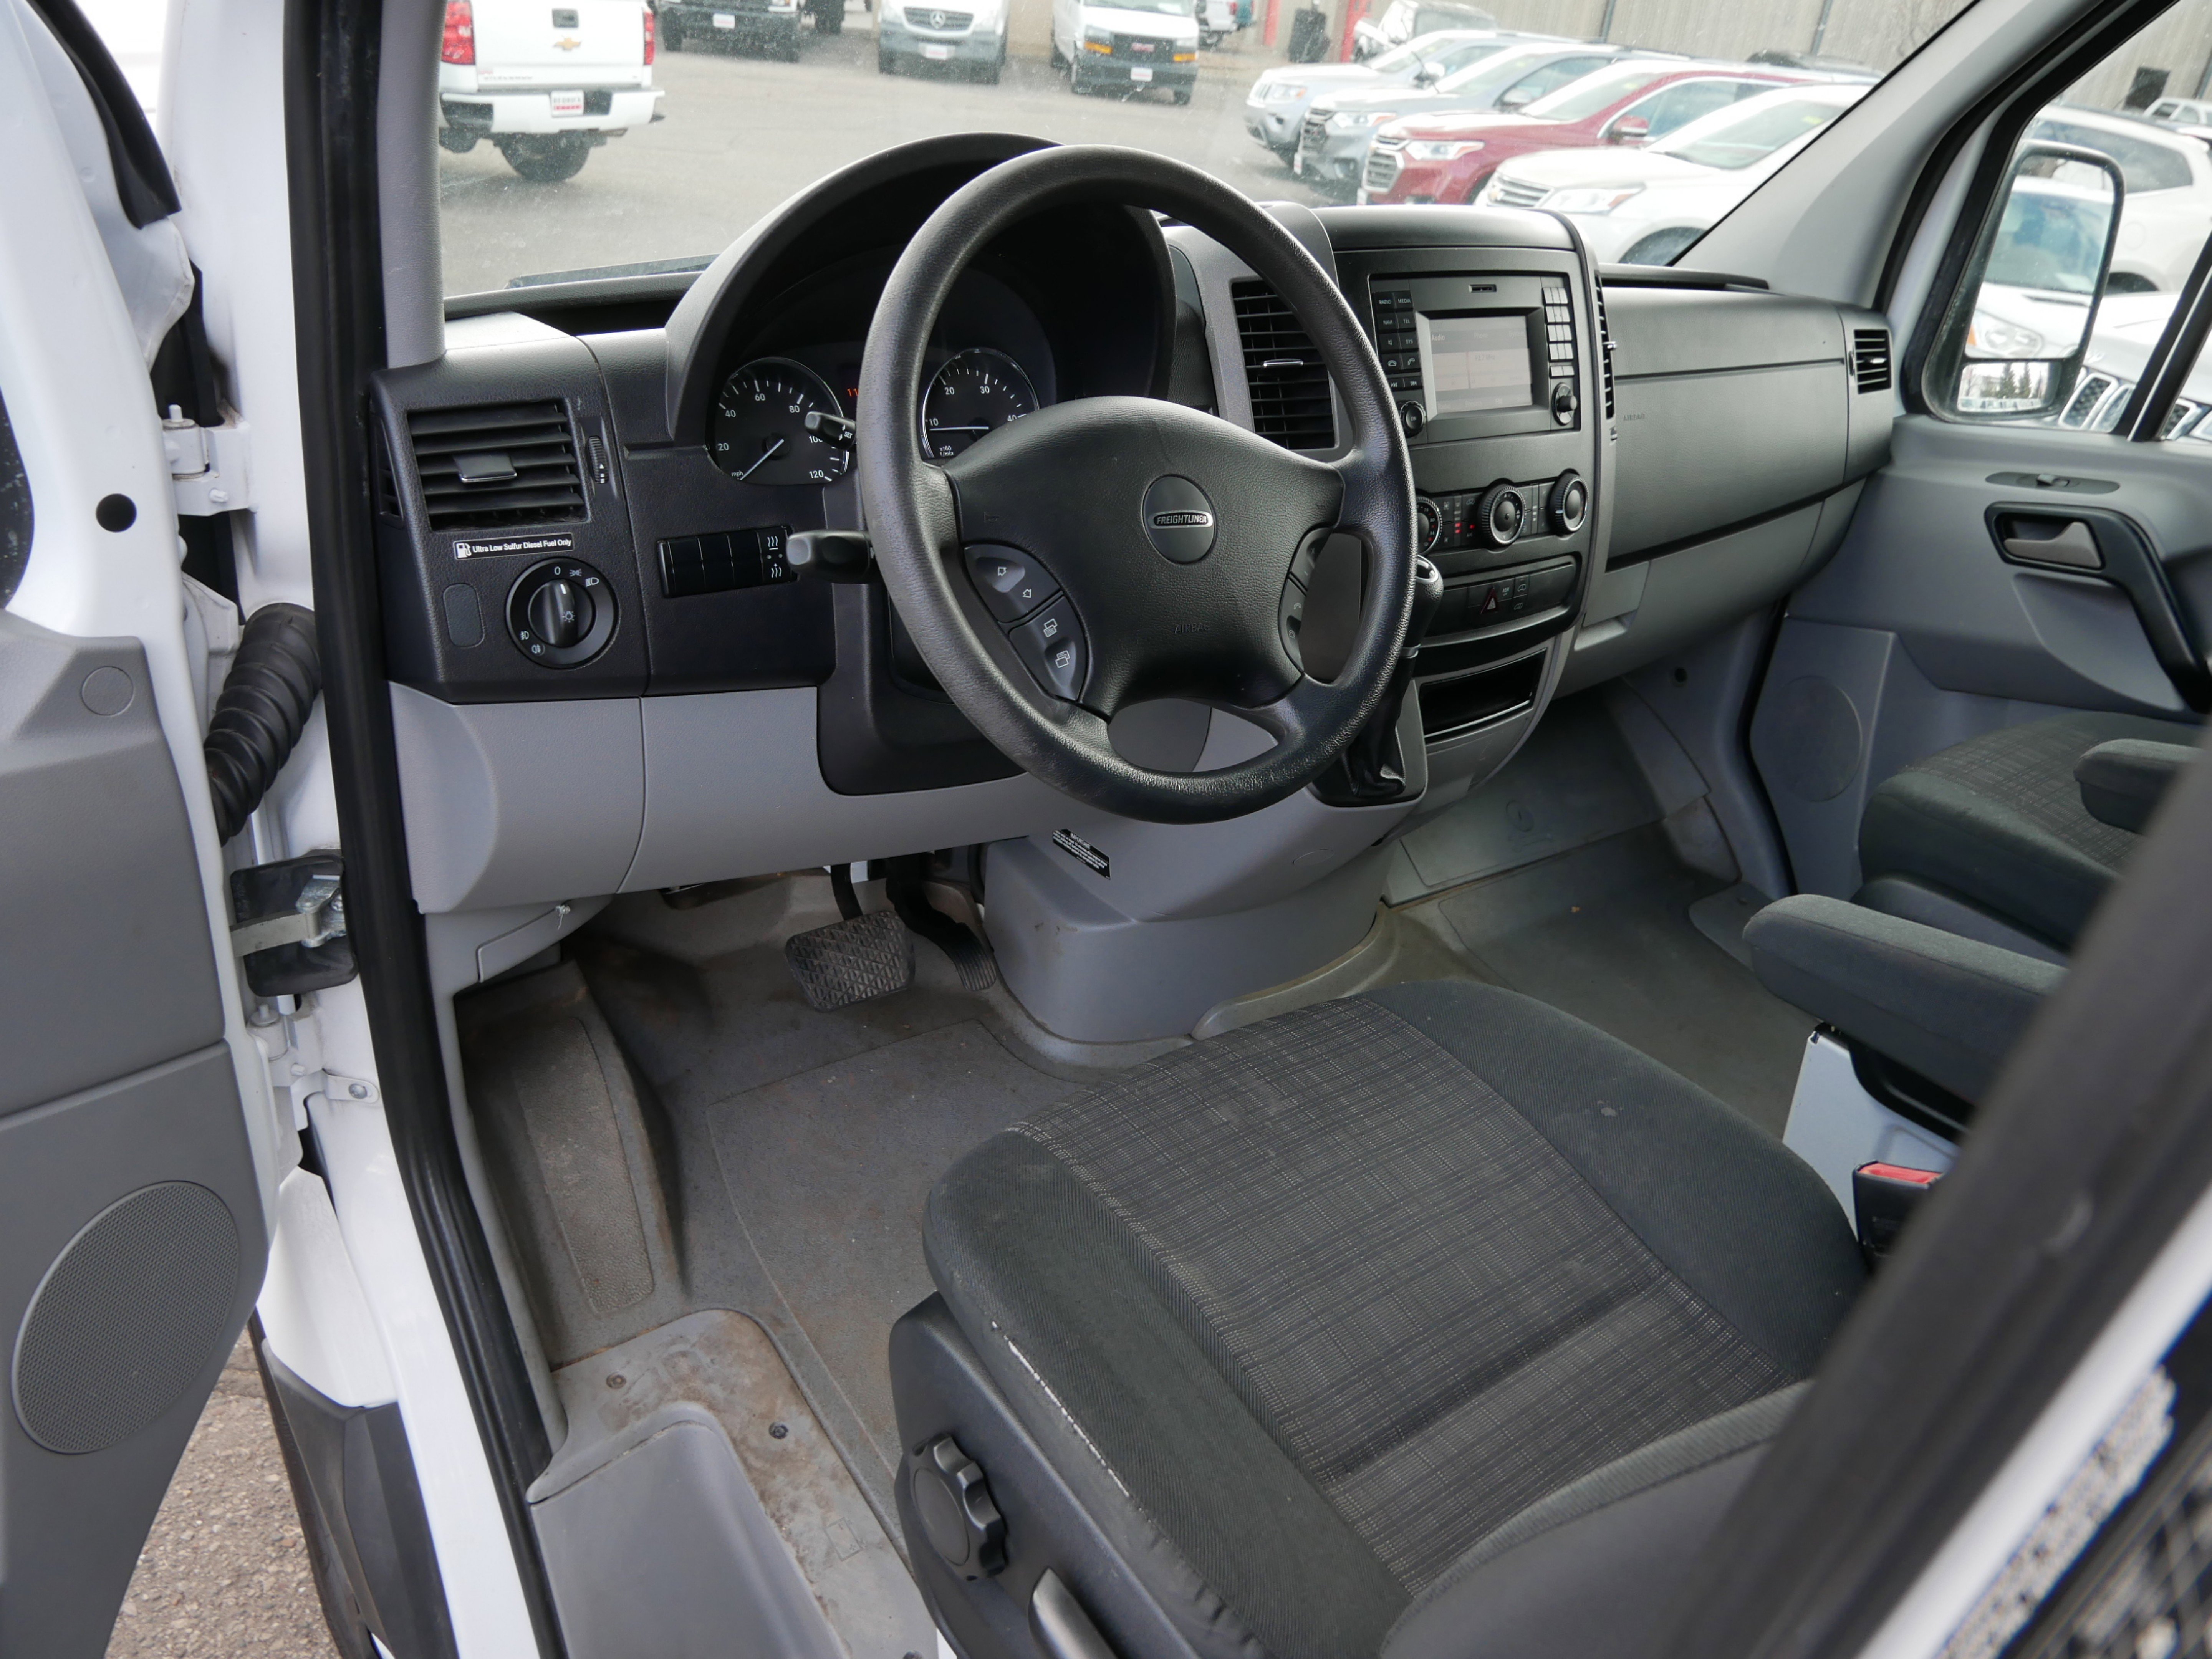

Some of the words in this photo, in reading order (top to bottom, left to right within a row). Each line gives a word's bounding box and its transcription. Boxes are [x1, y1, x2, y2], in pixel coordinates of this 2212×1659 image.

[755, 393, 766, 401] 60
[725, 409, 737, 417] 40
[789, 405, 800, 413] 80
[929, 418, 939, 426] 10
[718, 443, 729, 451] 20
[809, 470, 824, 478] 120
[1156, 515, 1207, 525] FREIGHTLINER
